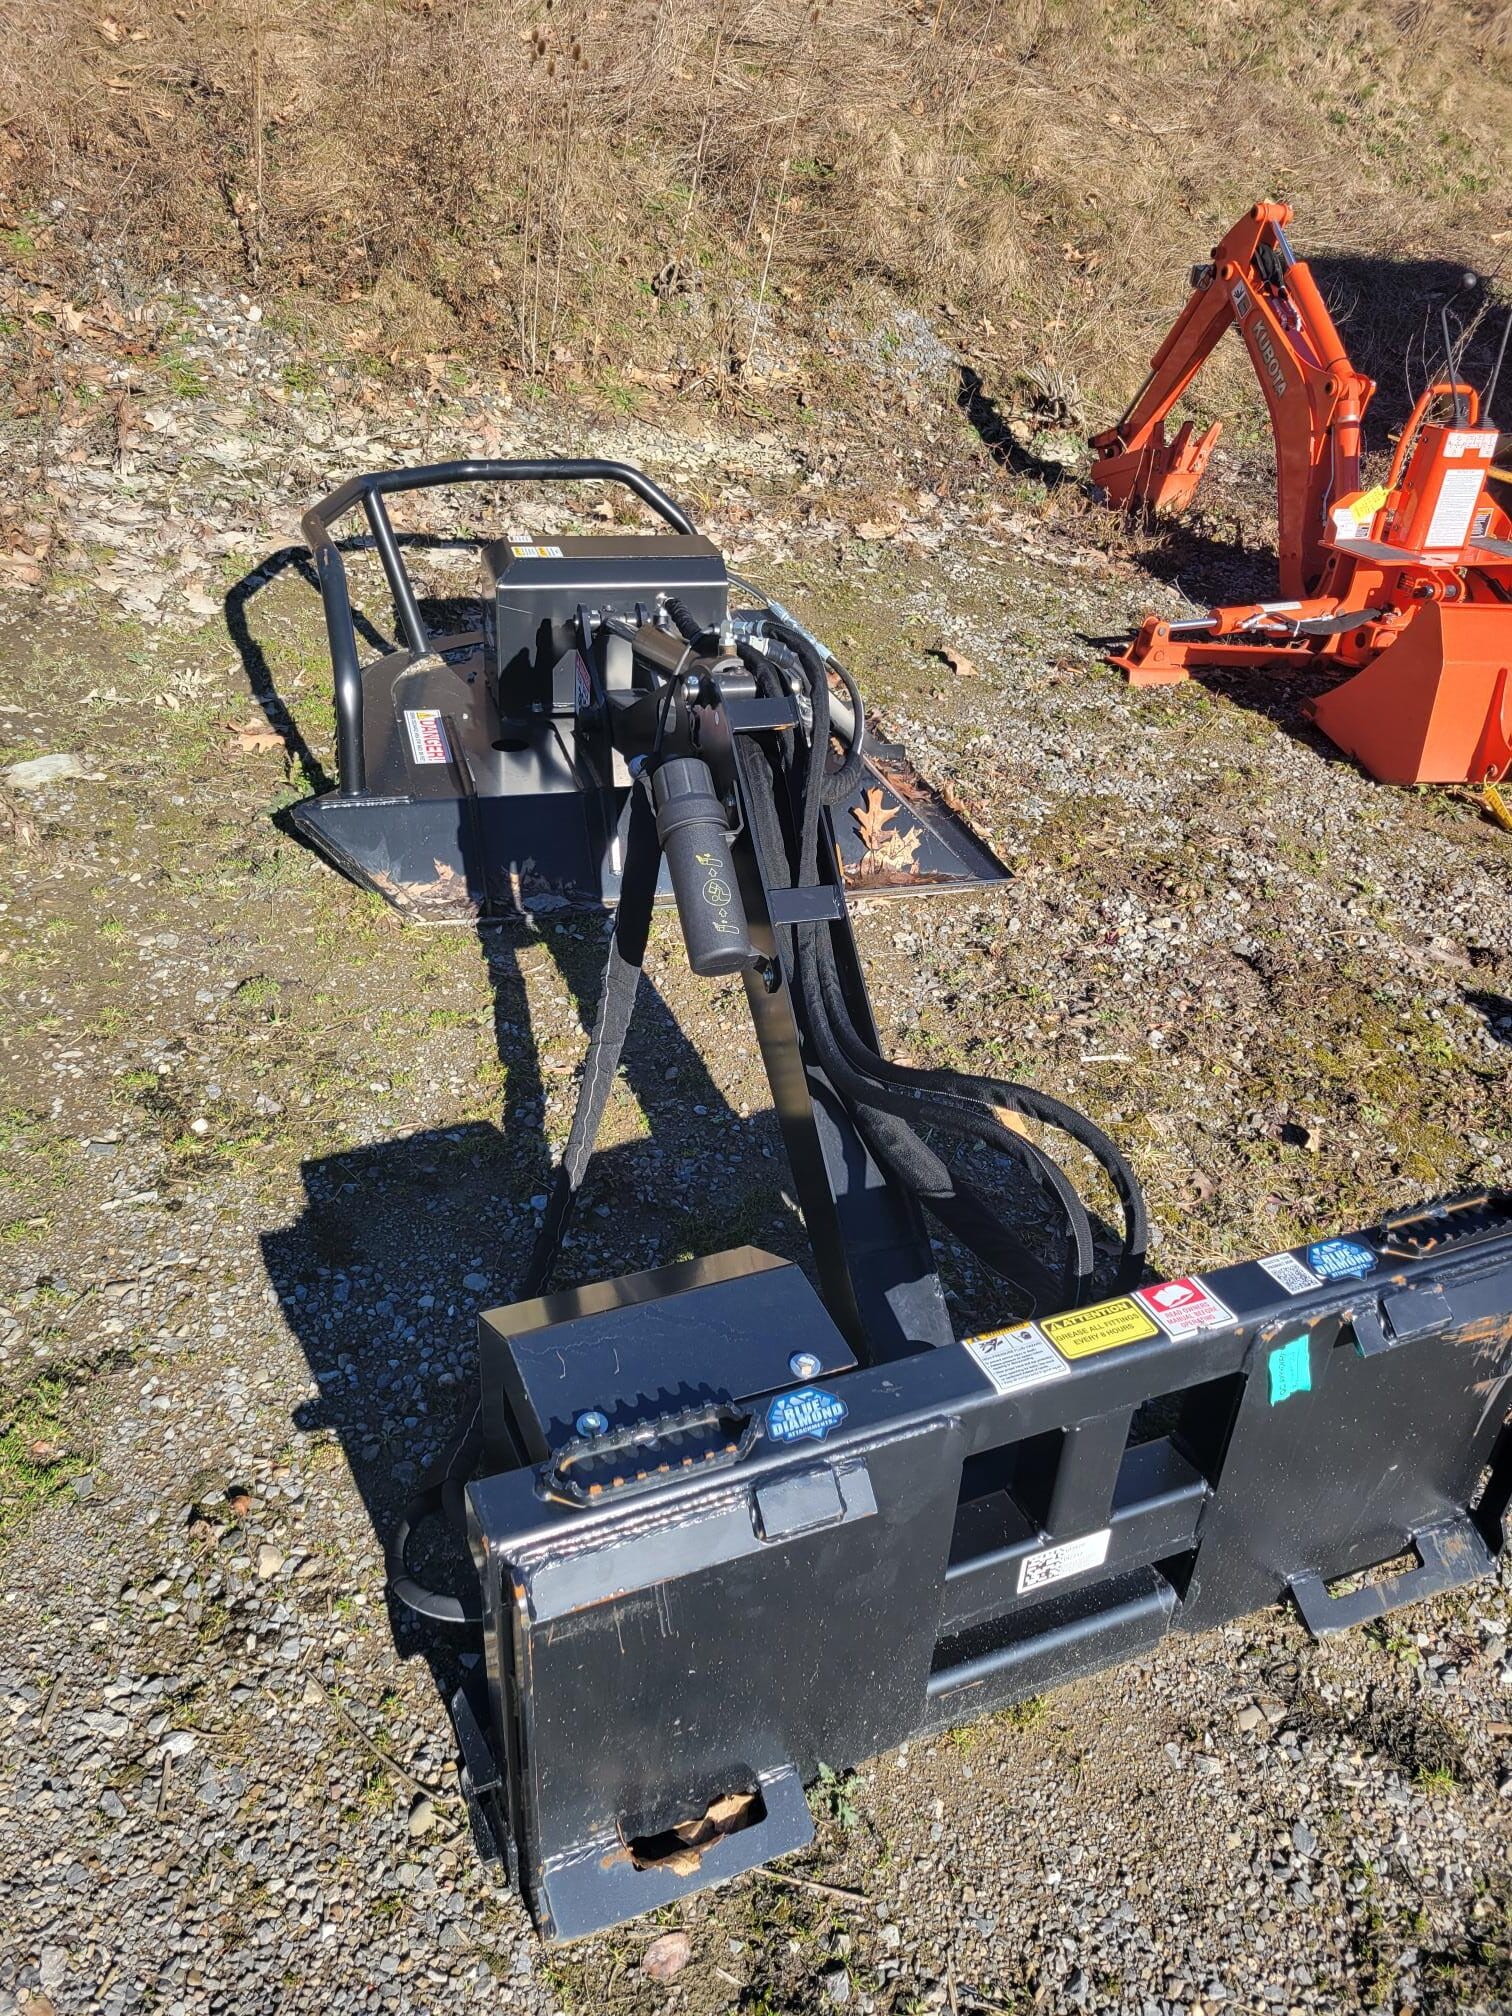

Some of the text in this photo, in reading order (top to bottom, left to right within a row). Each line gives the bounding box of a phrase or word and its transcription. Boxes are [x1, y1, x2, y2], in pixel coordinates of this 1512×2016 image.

[1253, 320, 1287, 397] KUBOTA
[419, 719, 446, 763] DANGER!
[1316, 1252, 1374, 1274] DIAMOND
[1321, 1248, 1352, 1264] BLUE
[1062, 1303, 1129, 1327] ATTENTION
[1164, 1302, 1210, 1318] READ OWNERS
[1167, 1306, 1219, 1325] MANUAL BEFORE
[1056, 1313, 1140, 1342] GREASE ALL FITTINGS
[1073, 1333, 1100, 1345] EVERY
[1107, 1324, 1135, 1337] HOURS
[772, 1402, 844, 1435] DIAMOND
[783, 1399, 822, 1420] BLUE
[787, 1420, 833, 1438] ATTACHMENTS
